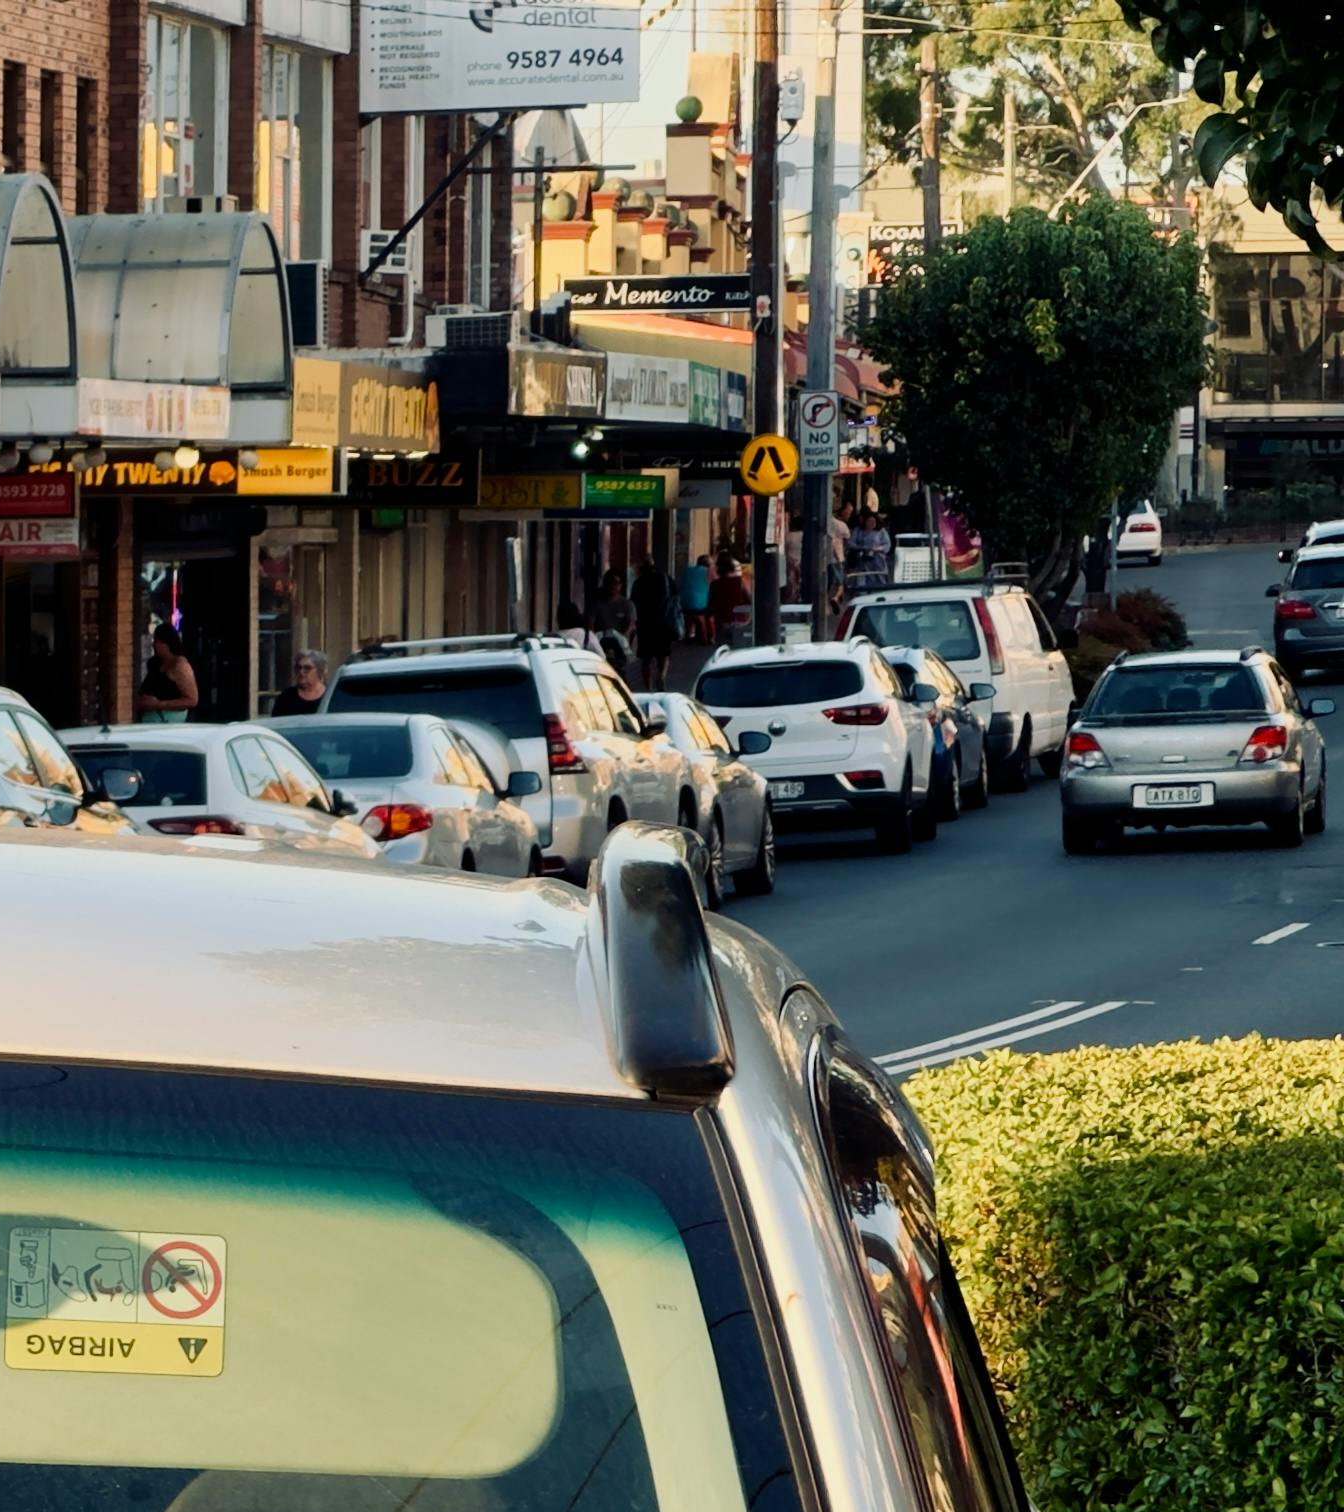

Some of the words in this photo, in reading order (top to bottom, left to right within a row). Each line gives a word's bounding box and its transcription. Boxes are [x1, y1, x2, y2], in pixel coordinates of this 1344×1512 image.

[523, 7, 597, 26] dental
[467, 62, 502, 73] phone
[507, 49, 562, 69] 9587
[569, 47, 625, 66] 4964
[870, 226, 956, 240] KOGAH
[604, 280, 715, 306] Memento
[809, 432, 831, 444] NO
[804, 447, 834, 456] RIGHT
[286, 464, 328, 479] Burger
[806, 459, 834, 468] TURN
[113, 462, 206, 485] TWENTY
[367, 462, 463, 486] BUZZ
[31, 484, 66, 497] 2728
[26, 1334, 136, 1359] AIRBAG
